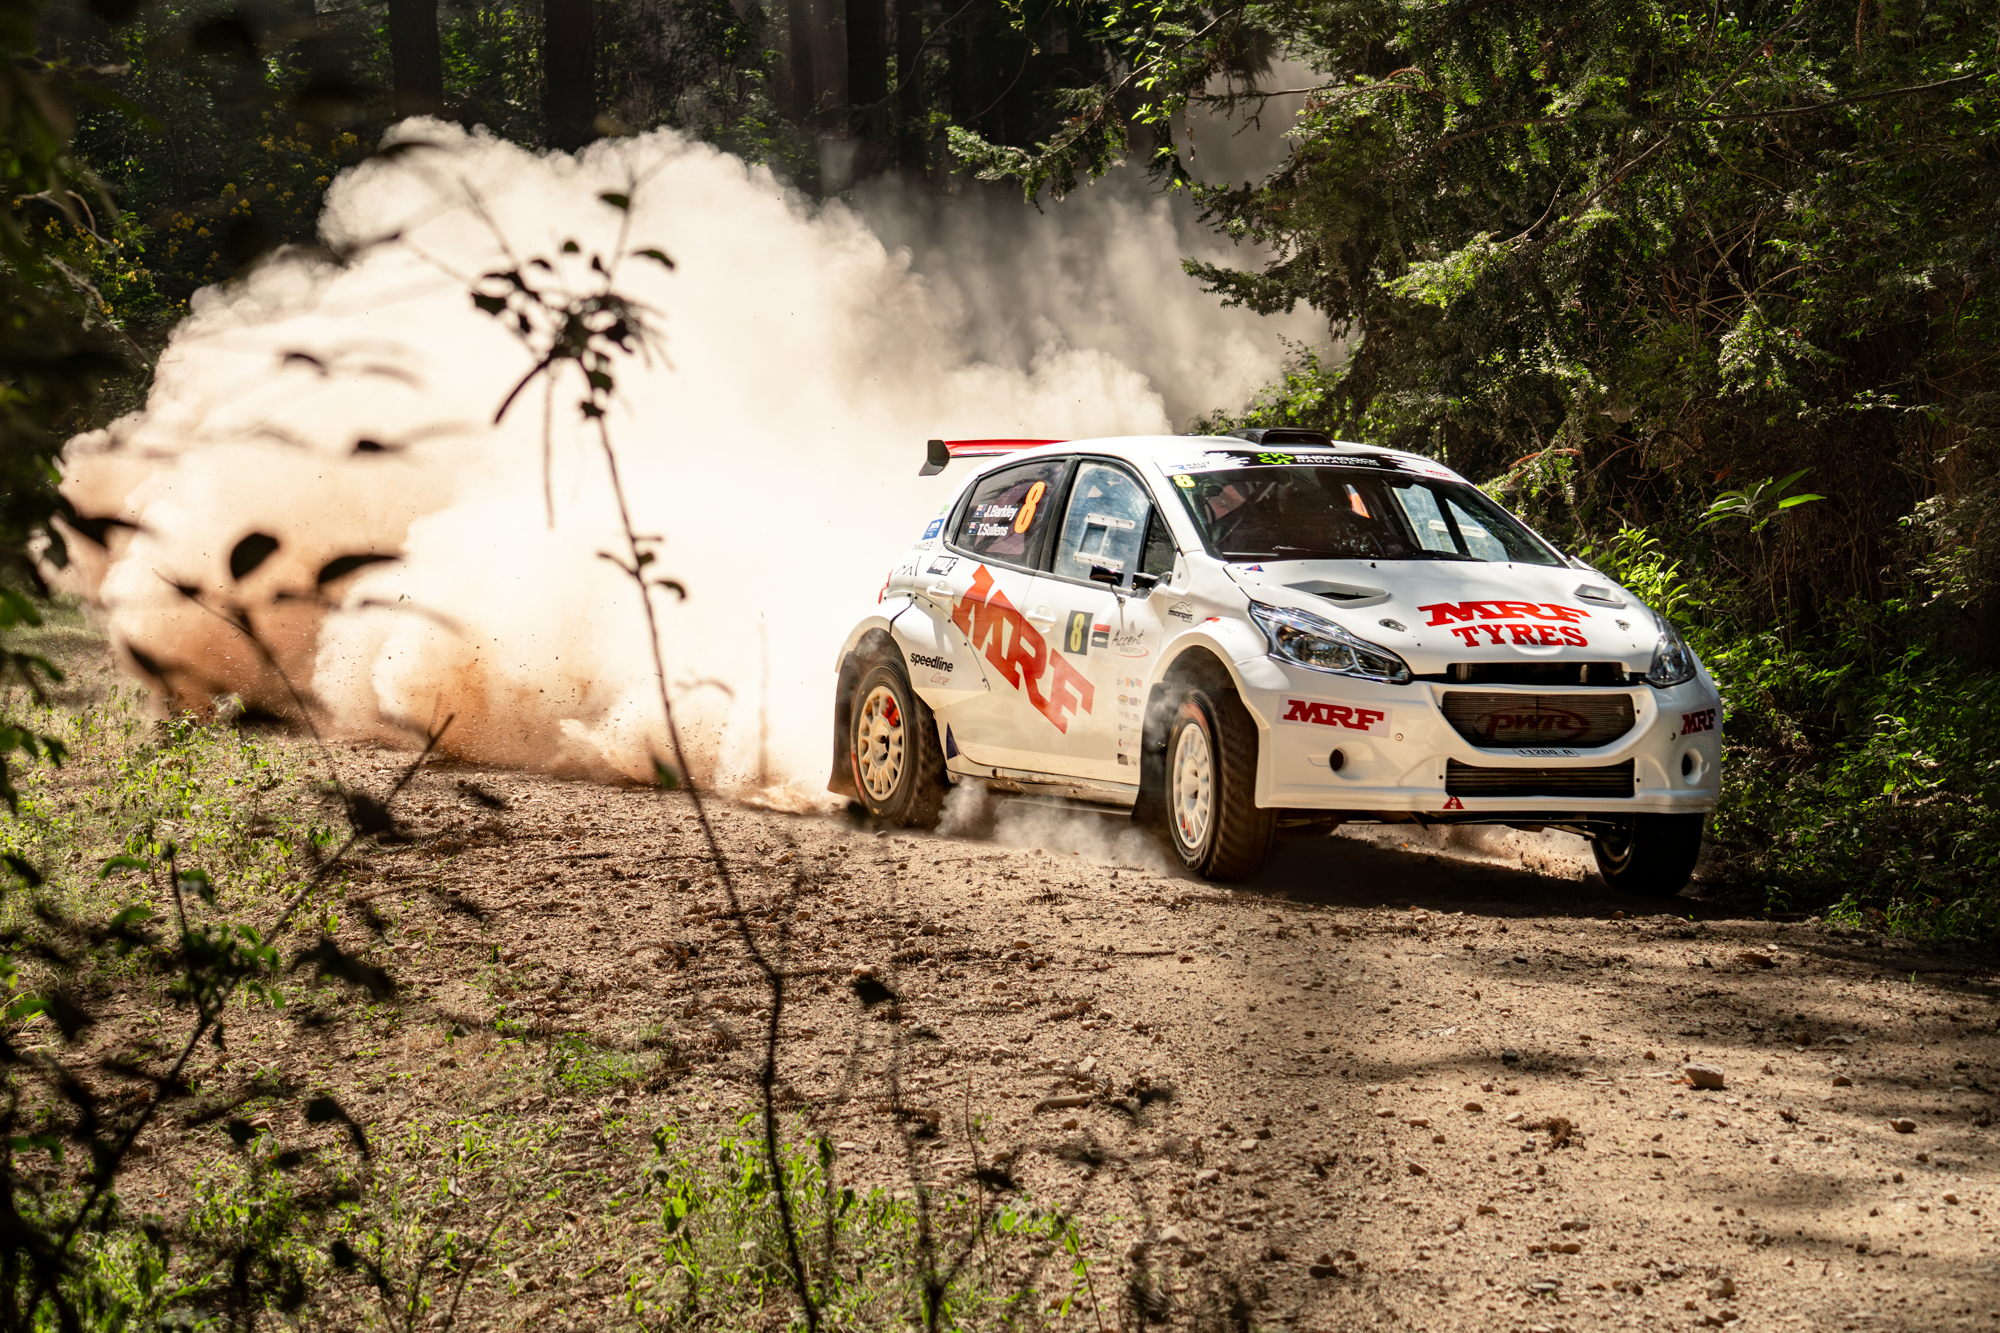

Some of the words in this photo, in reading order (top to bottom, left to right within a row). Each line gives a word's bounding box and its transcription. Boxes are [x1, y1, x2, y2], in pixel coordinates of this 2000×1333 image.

[1294, 454, 1378, 464] SHAMROCK
[1173, 474, 1195, 488] 8
[1014, 481, 1046, 534] 8
[977, 523, 1009, 536] T.Sullens
[1417, 600, 1592, 627] MRF
[1070, 613, 1085, 652] 8
[1111, 629, 1144, 646] Accent
[1450, 624, 1588, 647] TYRES
[951, 563, 1095, 735] MRF
[910, 653, 953, 672] speedline
[1283, 699, 1384, 731] MRF
[1681, 708, 1716, 735] MRF
